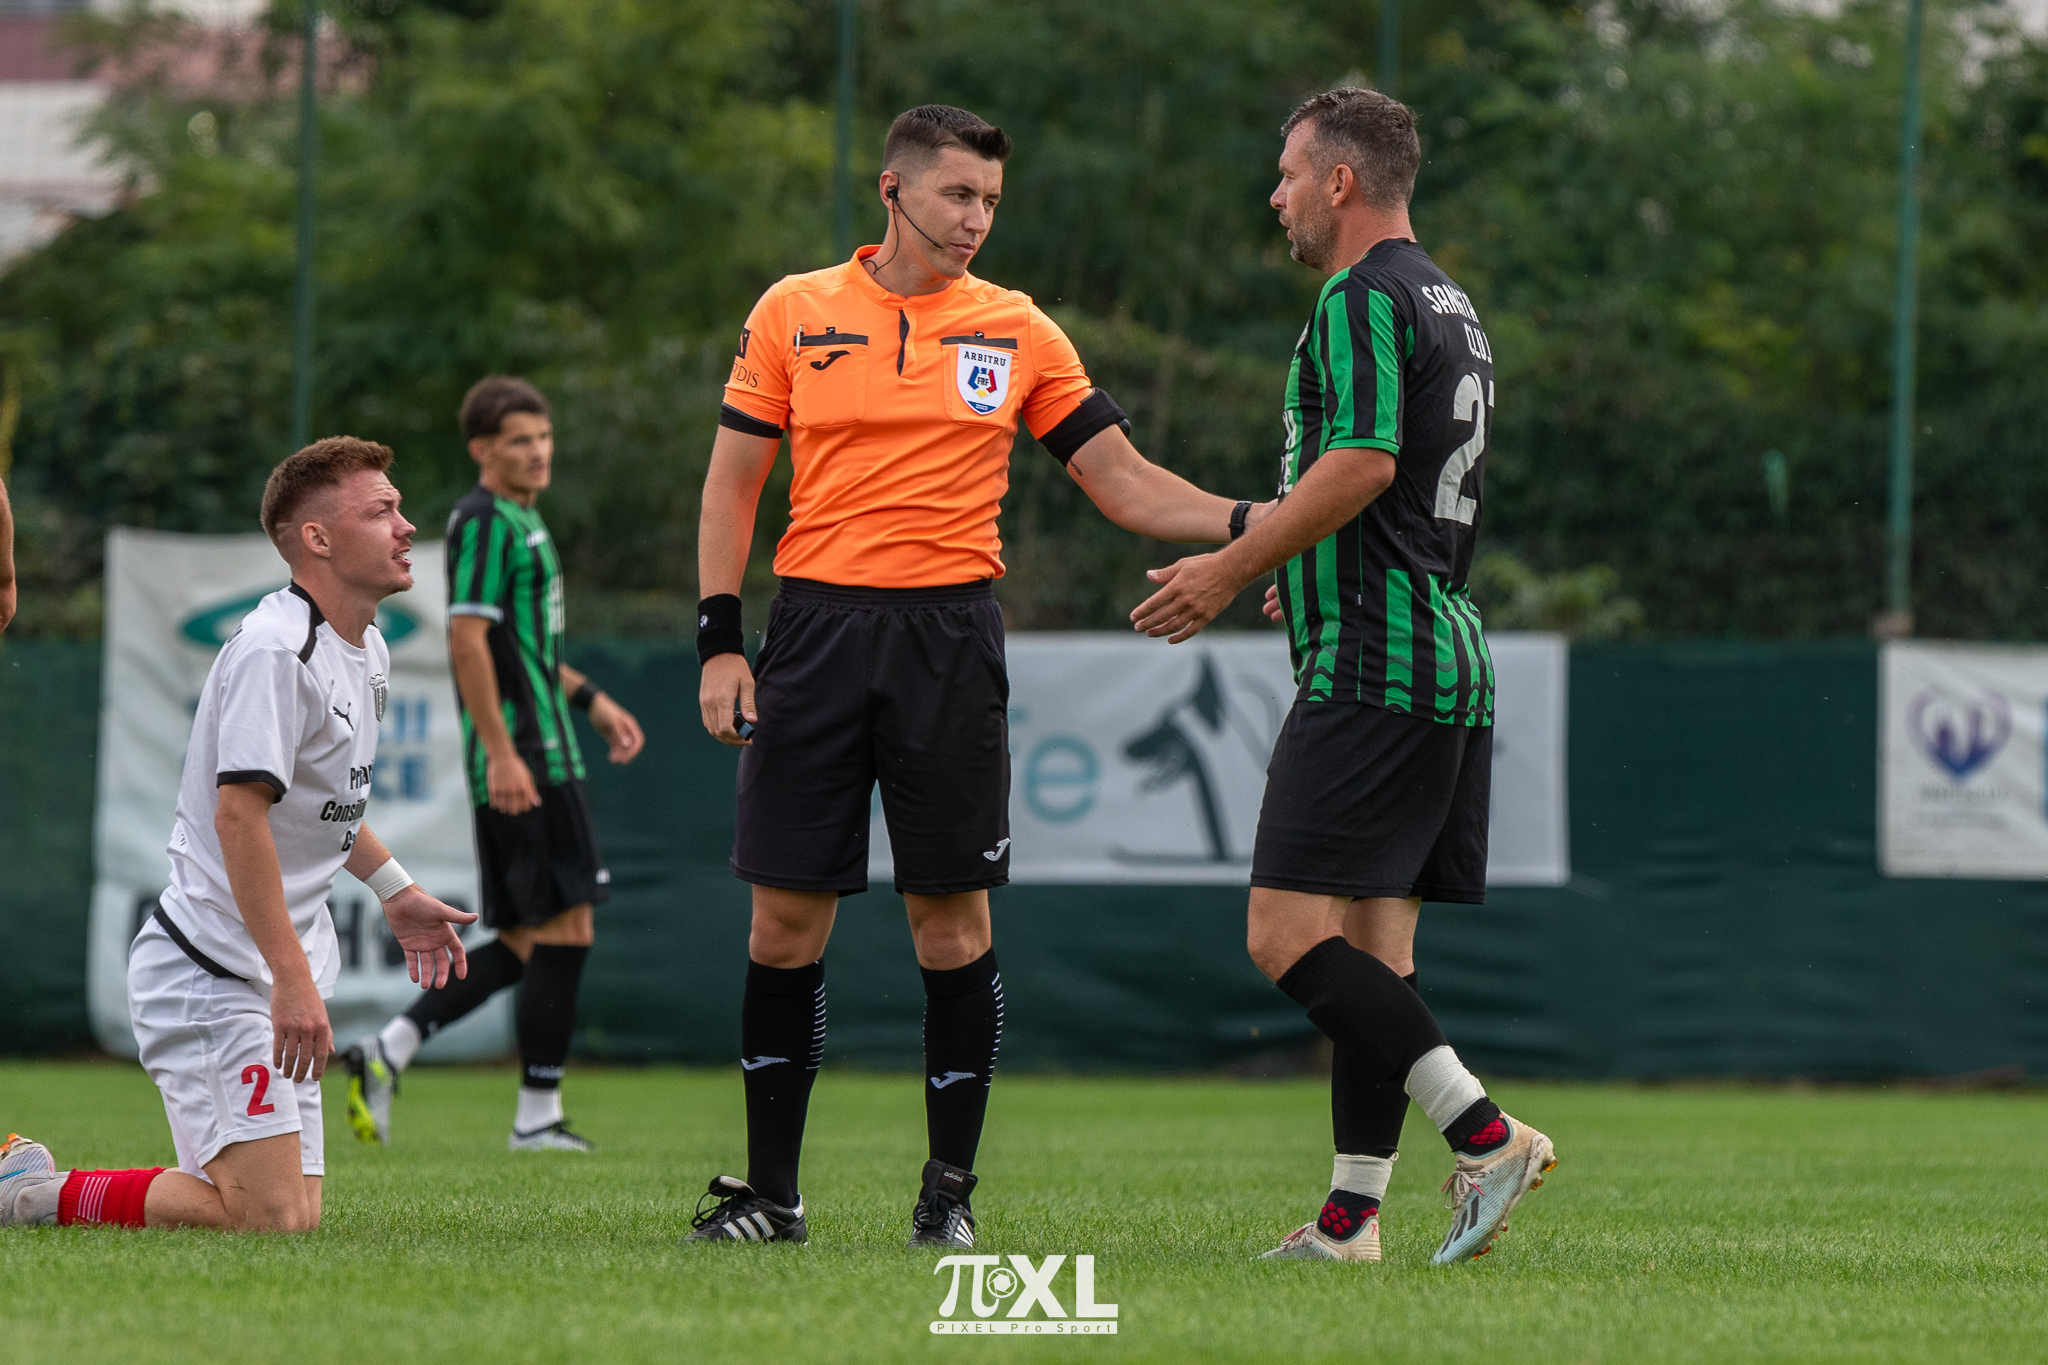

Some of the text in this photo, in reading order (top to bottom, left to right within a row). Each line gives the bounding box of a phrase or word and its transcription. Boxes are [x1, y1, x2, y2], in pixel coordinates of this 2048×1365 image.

[964, 351, 1006, 366] ARBITRU
[977, 377, 989, 386] FRF
[241, 1064, 275, 1116] 2
